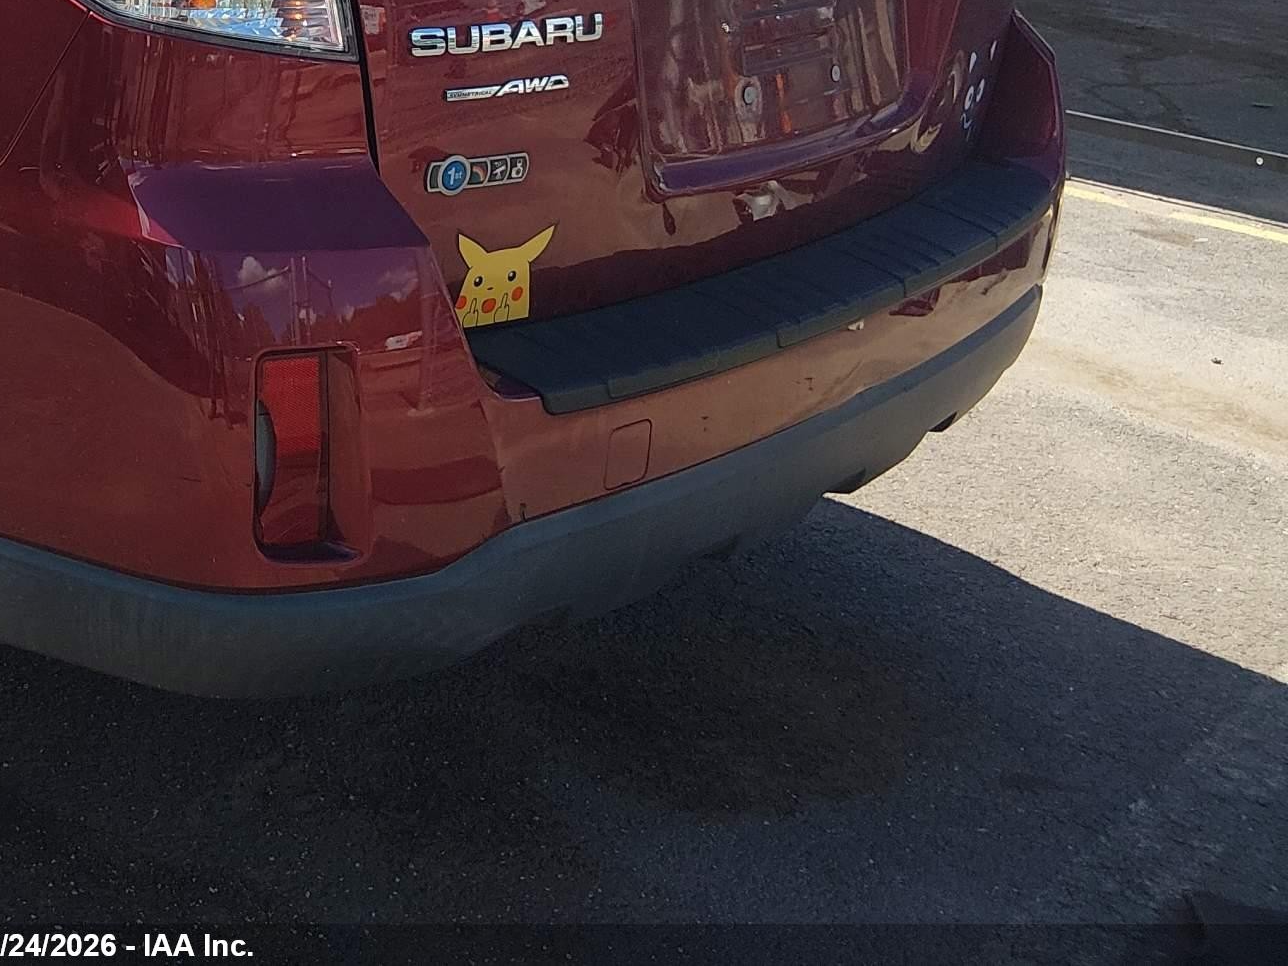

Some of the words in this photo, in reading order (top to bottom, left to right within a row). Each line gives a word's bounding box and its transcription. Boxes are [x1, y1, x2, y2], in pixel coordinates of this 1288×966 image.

[410, 13, 603, 58] SUBARU
[495, 74, 570, 97] AWD
[447, 166, 463, 186] 1st
